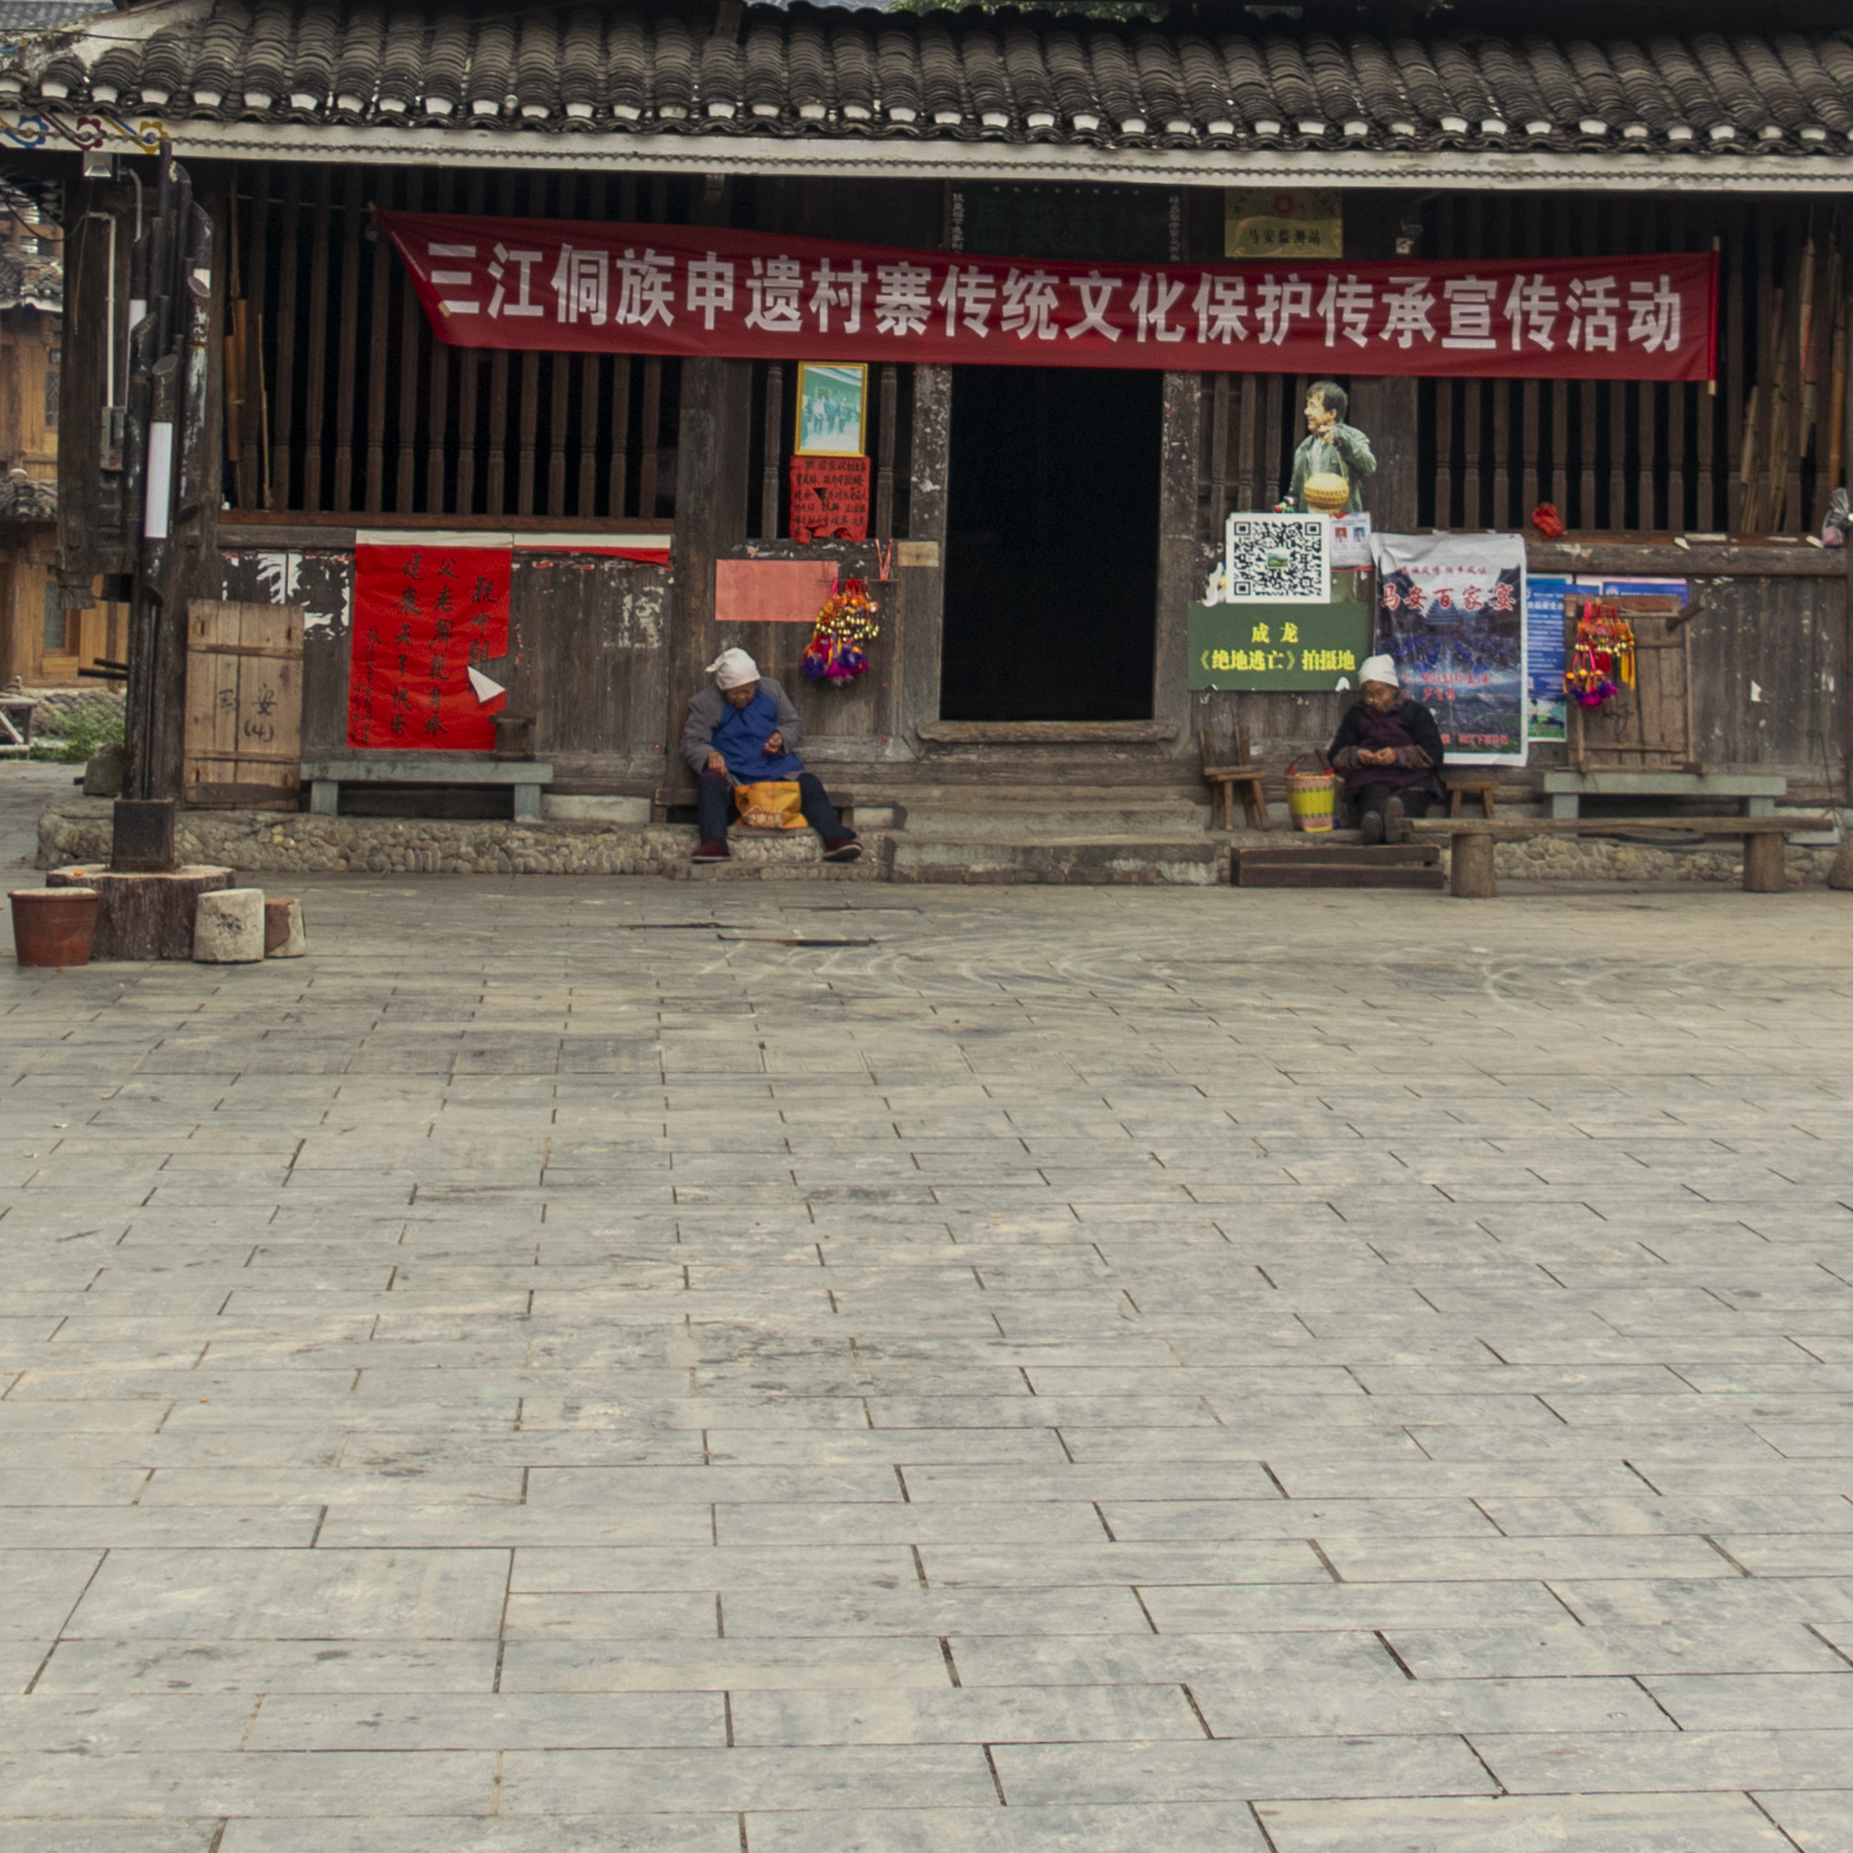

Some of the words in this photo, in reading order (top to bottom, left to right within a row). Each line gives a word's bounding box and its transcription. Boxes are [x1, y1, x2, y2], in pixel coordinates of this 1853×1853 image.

[427, 241, 1682, 353] 三江侗族申遗村寨传统文化保护传承宣传活动
[1382, 583, 1516, 611] 马安百家宴
[1251, 622, 1299, 644] 成龙
[1200, 650, 1356, 671] 《绝地逃亡》拍摄地
